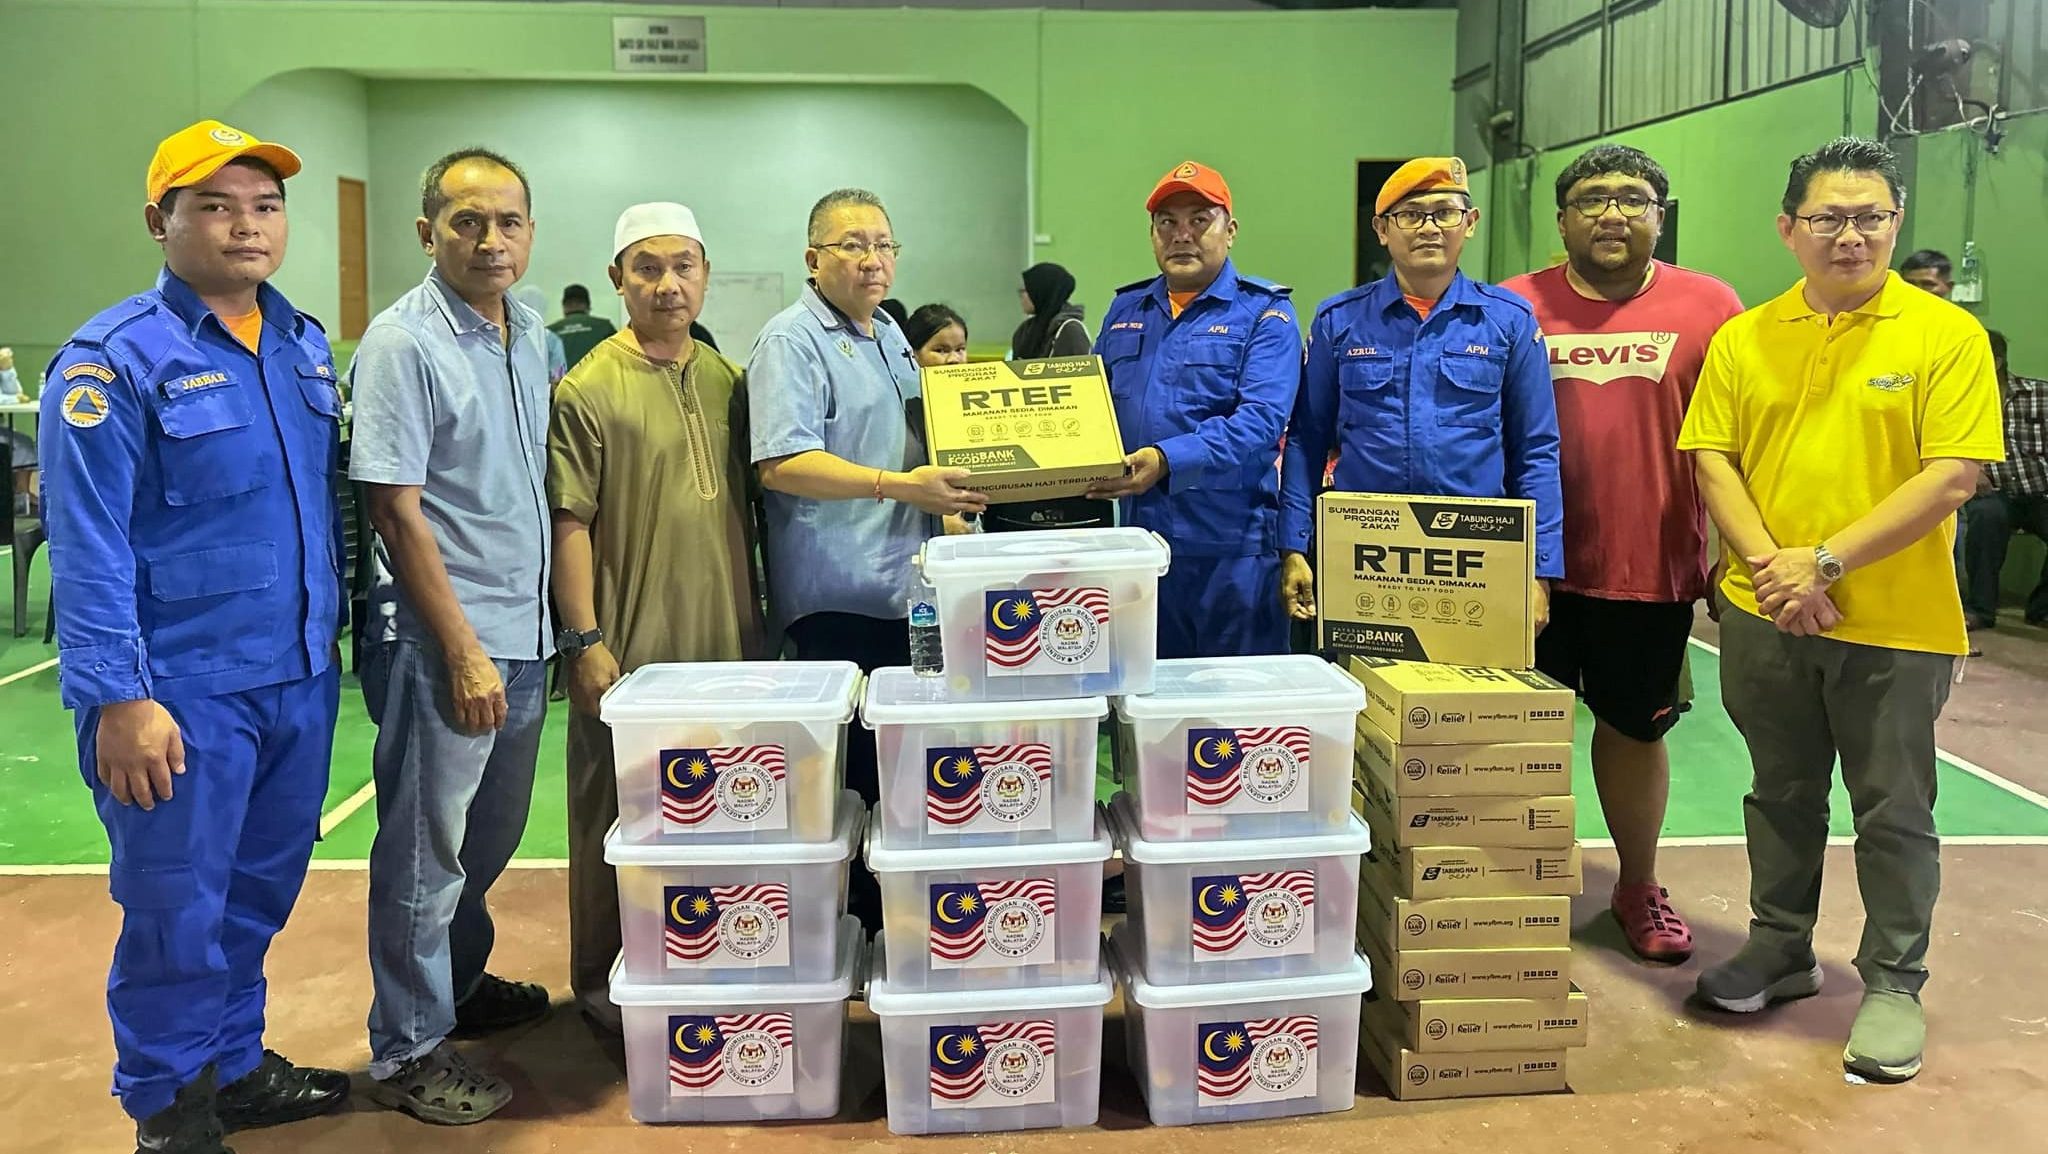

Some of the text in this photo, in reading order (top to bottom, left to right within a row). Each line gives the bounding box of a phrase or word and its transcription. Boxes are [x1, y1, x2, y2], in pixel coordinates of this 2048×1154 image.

[1208, 325, 1229, 334] APM
[1346, 347, 1376, 356] AZRUL
[1466, 345, 1488, 355] APM
[934, 366, 996, 375] SUMBANGAN
[960, 385, 1072, 411] RTEF
[963, 409, 1007, 417] MAKANAN
[980, 450, 1014, 459] BANK
[970, 482, 1034, 492] PENGURUSAN
[1035, 480, 1056, 488] HAJI
[1328, 506, 1400, 516] SUMBANGAN
[1344, 515, 1399, 523] PROGRAM
[1460, 515, 1515, 524] TABUNG HAJI
[1361, 522, 1399, 531] ZAKAT
[1354, 544, 1485, 578] RTEF
[1354, 574, 1403, 583] MAKANAN
[1439, 580, 1486, 589] DIMAKAN
[1042, 608, 1072, 639] PENGURUSAN
[1077, 609, 1096, 635] BENCANA
[1366, 630, 1404, 643] BANK
[1441, 713, 1465, 723] Relief
[1243, 747, 1272, 778] PENGURUSAN
[1278, 749, 1296, 773] BENCANA
[1436, 765, 1461, 774] Relief
[718, 766, 747, 798] PENGURUSAN
[753, 767, 773, 792] BENCANA
[984, 766, 1013, 797] PENGURUSAN
[1018, 767, 1038, 791] BENCANA
[1249, 892, 1277, 924] PENGURUSAN
[1282, 893, 1301, 917] BENCANA
[721, 905, 750, 935] PENGURUSAN
[755, 906, 776, 930] BENCANA
[988, 901, 1017, 933] PENGURUSAN
[1023, 902, 1042, 926] BENCANA
[1437, 920, 1461, 929] Relief
[1458, 1024, 1481, 1034] Relief
[725, 1034, 754, 1063] PENGURUSAN
[760, 1035, 779, 1058] BENCANA
[1253, 1038, 1282, 1069] PENGURUSAN
[1287, 1038, 1304, 1061] BENCANA
[987, 1042, 1016, 1074] PENGURUSAN
[1022, 1044, 1041, 1066] BENCANA
